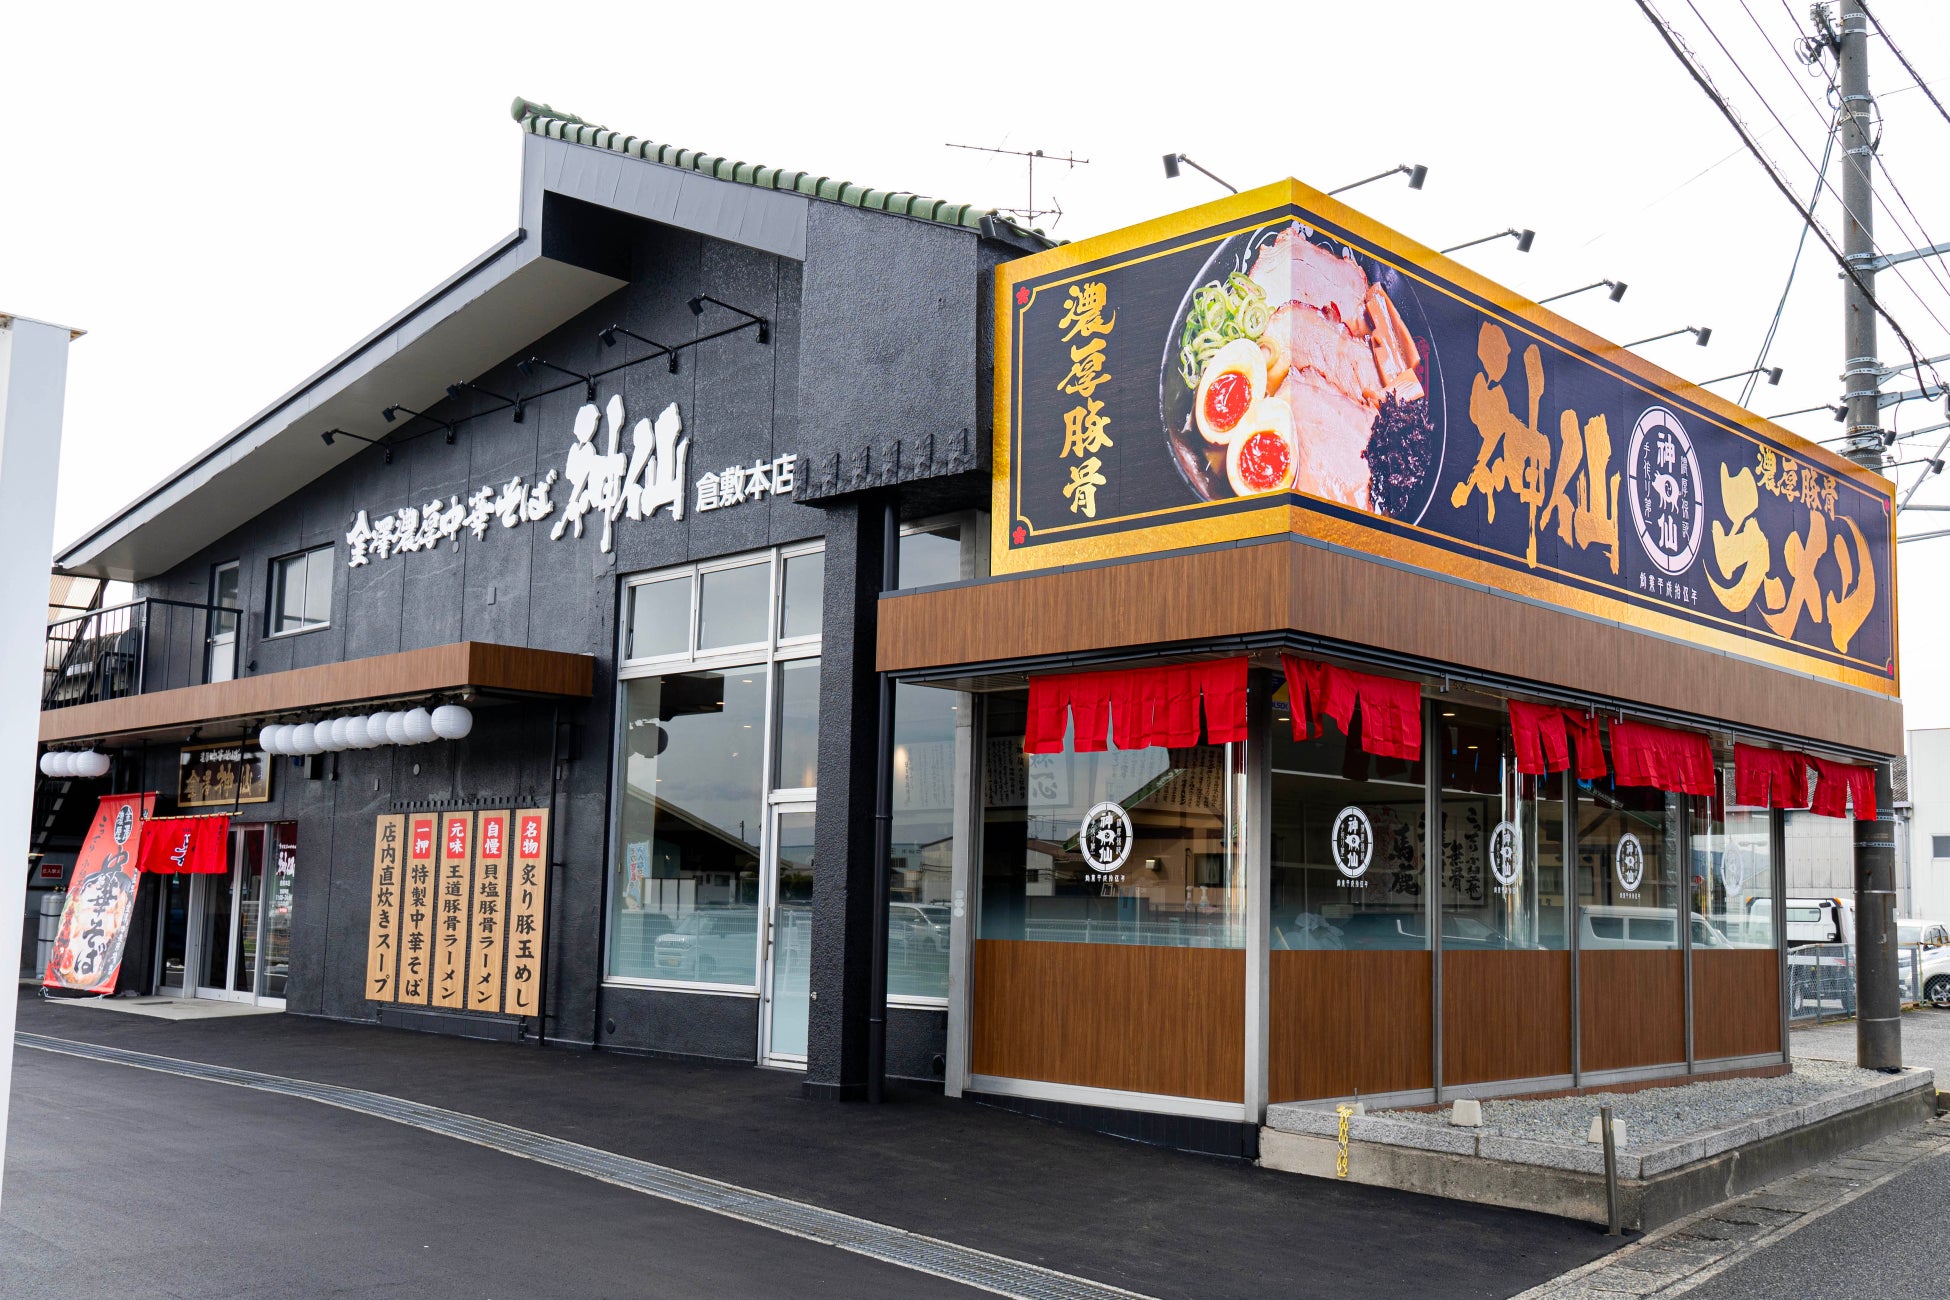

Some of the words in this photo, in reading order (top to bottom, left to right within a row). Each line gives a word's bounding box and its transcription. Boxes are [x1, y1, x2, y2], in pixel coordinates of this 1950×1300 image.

[1057, 282, 1116, 518] 濃厚豚骨
[1451, 321, 1621, 575] 神仙
[346, 469, 558, 567] 金澤濃厚中華そば
[550, 394, 689, 552] 神仙
[696, 453, 798, 512] 倉敷本店
[1656, 432, 1678, 552] 神仙
[1755, 444, 1839, 521] 濃厚豚骨
[415, 826, 430, 854] 一押
[449, 822, 465, 853] 元味
[484, 821, 501, 854] 自慢
[522, 821, 539, 854] 名物
[1098, 811, 1114, 862] 神仙
[74, 845, 129, 976] 中華そば
[374, 821, 397, 994] 店内直炊きスープ
[405, 863, 430, 998] 特製中華そば
[441, 864, 464, 1001] 王道豚骨ラーメン
[477, 863, 500, 1004] 貝塩豚骨ラーメン
[514, 863, 538, 1008] 炙り豚玉めし
